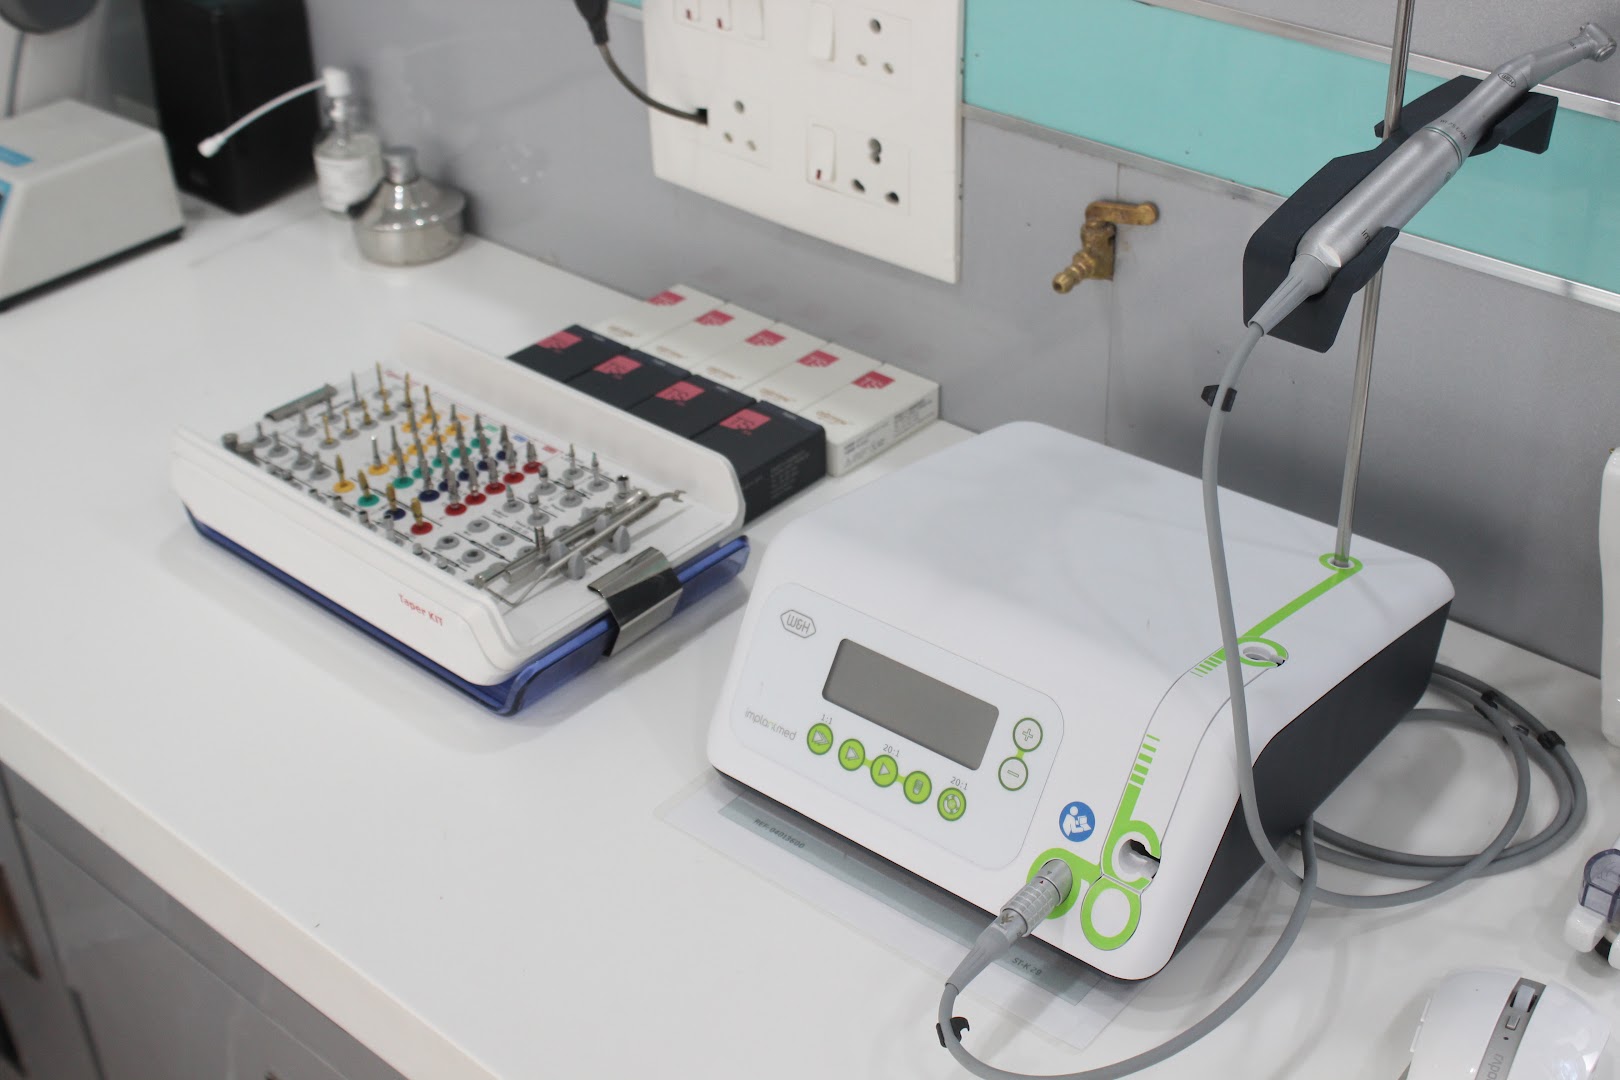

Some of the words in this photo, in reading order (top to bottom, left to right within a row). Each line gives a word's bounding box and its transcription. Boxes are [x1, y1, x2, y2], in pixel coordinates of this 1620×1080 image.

[399, 592, 427, 616] Taper
[427, 610, 443, 627] KIT
[786, 613, 811, 635] W&H
[820, 713, 834, 726] 1:1
[882, 743, 901, 758] 20:1
[950, 776, 969, 791] 20:1
[1486, 1053, 1504, 1080] rapo
